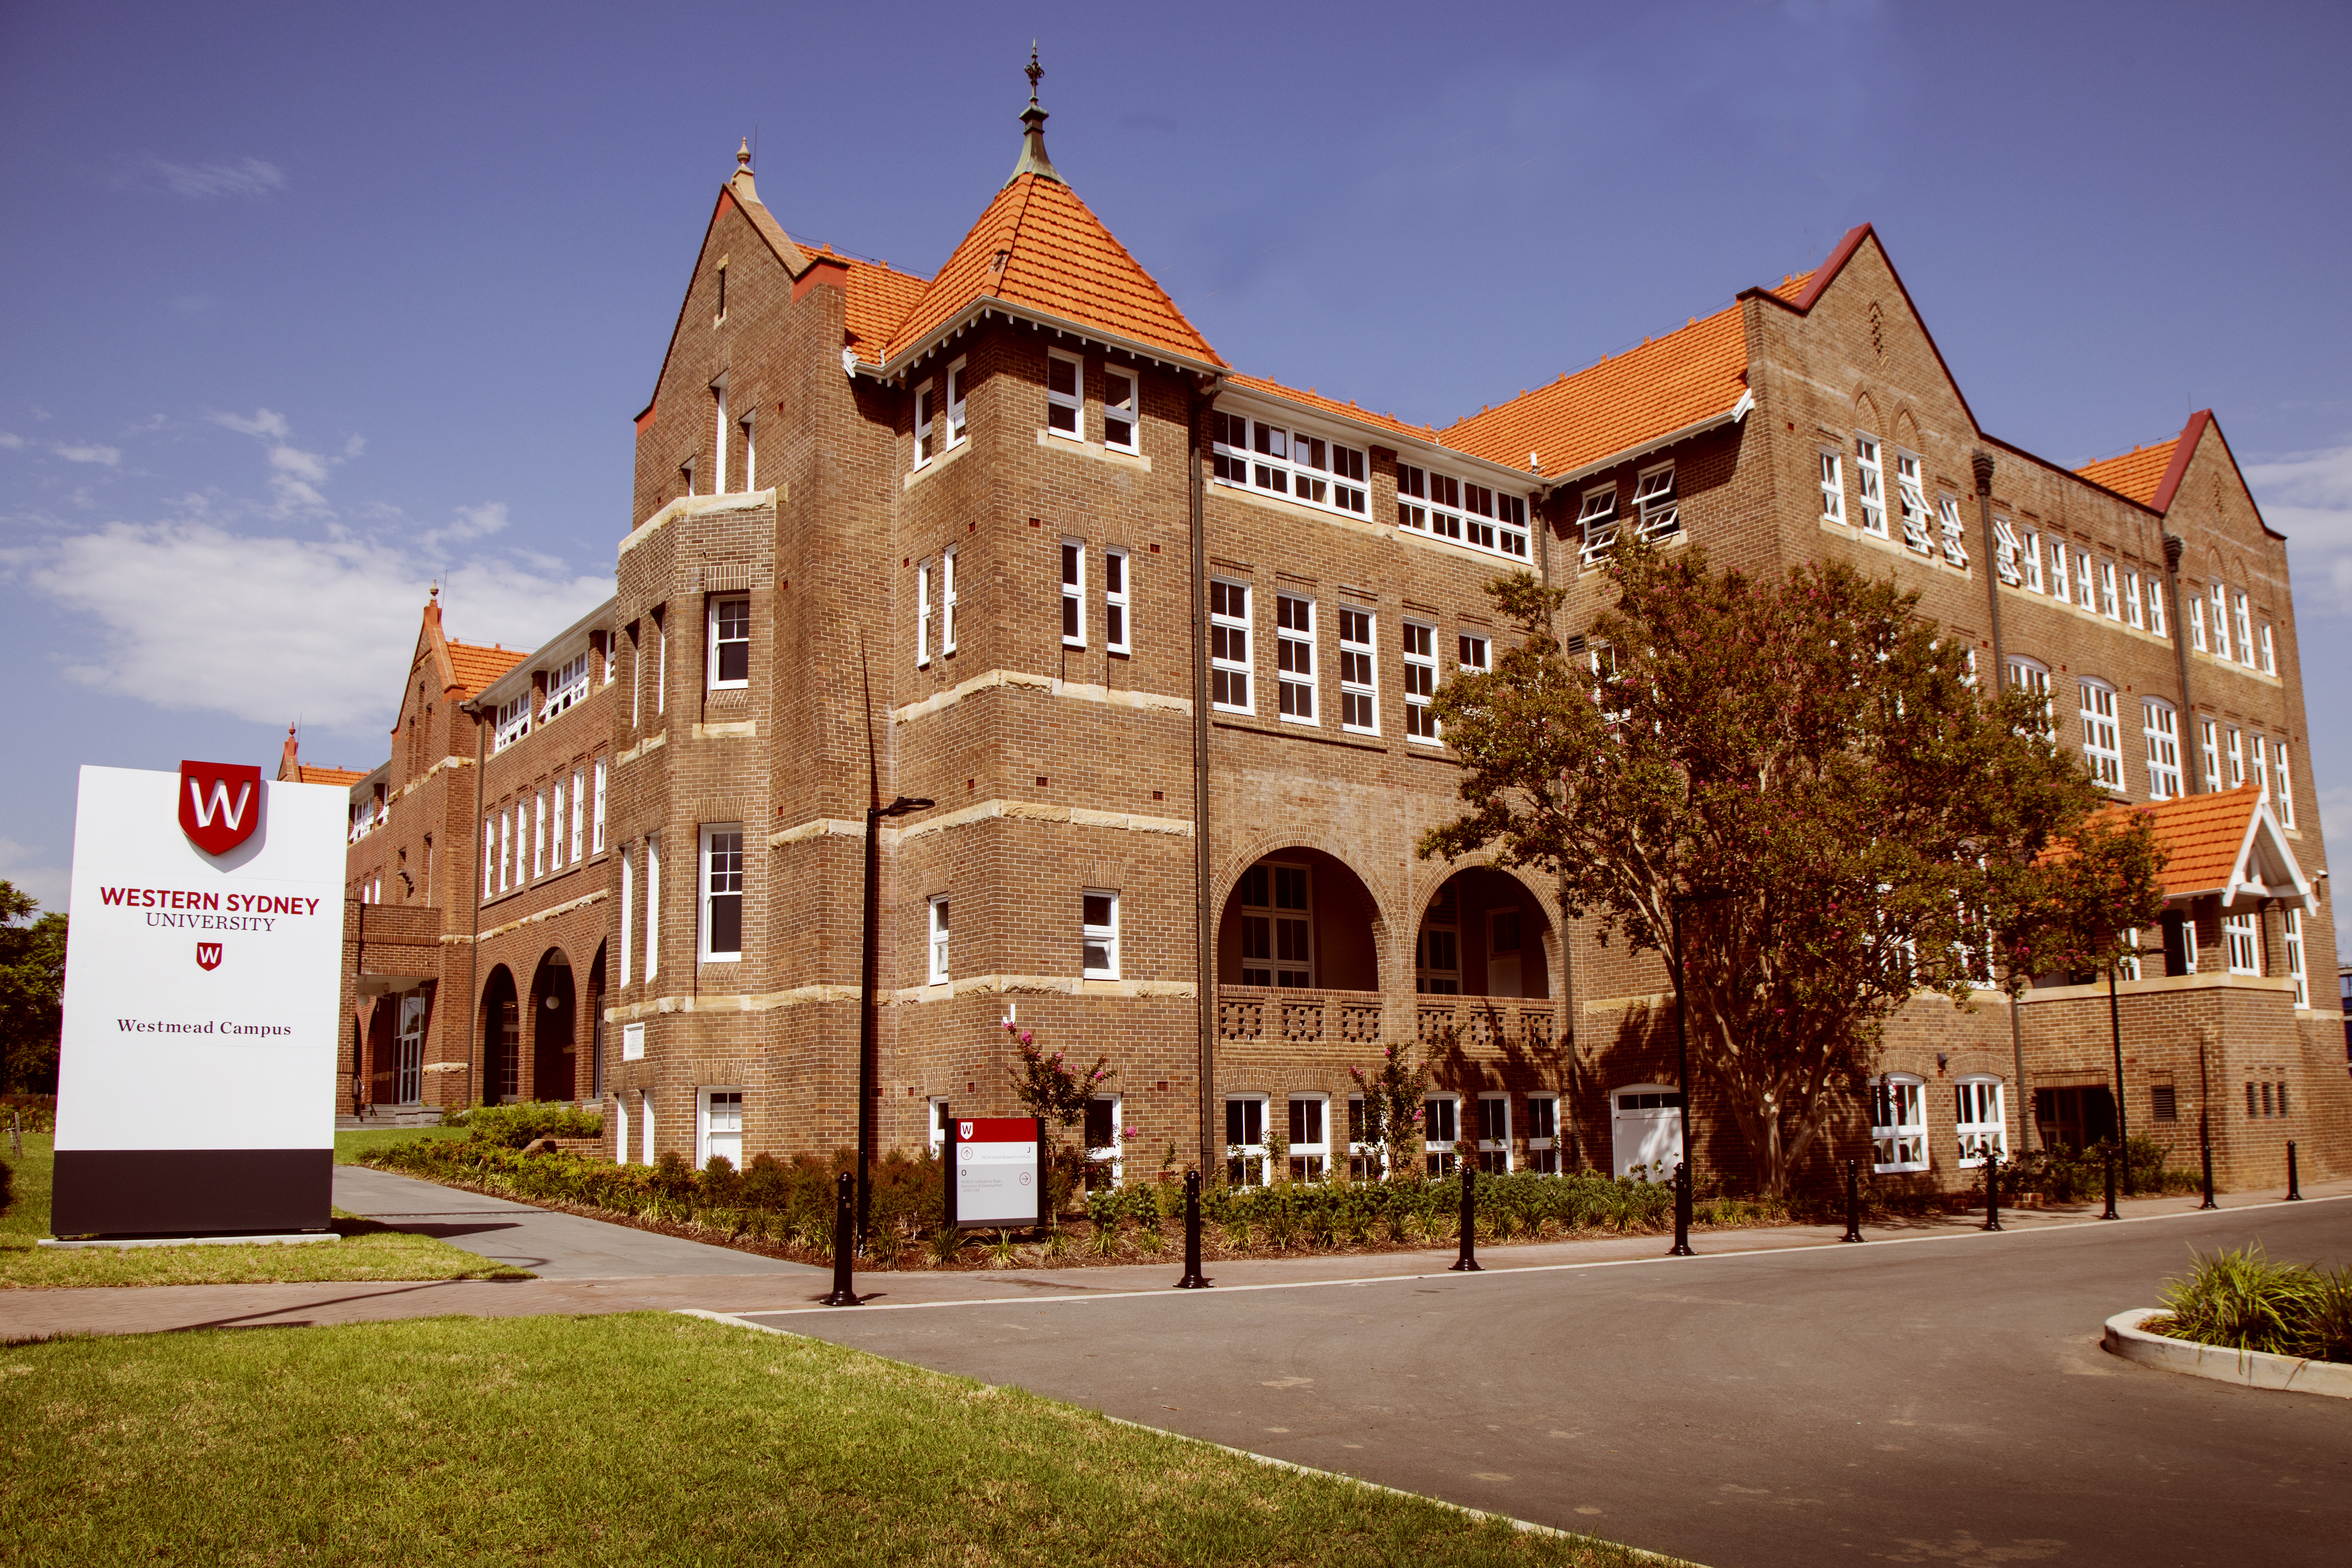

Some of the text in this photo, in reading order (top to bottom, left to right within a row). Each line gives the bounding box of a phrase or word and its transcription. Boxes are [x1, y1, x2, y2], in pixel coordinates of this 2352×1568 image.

[189, 776, 251, 831] W
[100, 887, 320, 915] WESTERN SYDNEY
[145, 912, 276, 931] UNIVERSITY
[199, 946, 220, 964] W
[117, 1019, 291, 1038] Westmead Campus
[962, 1125, 971, 1134] W
